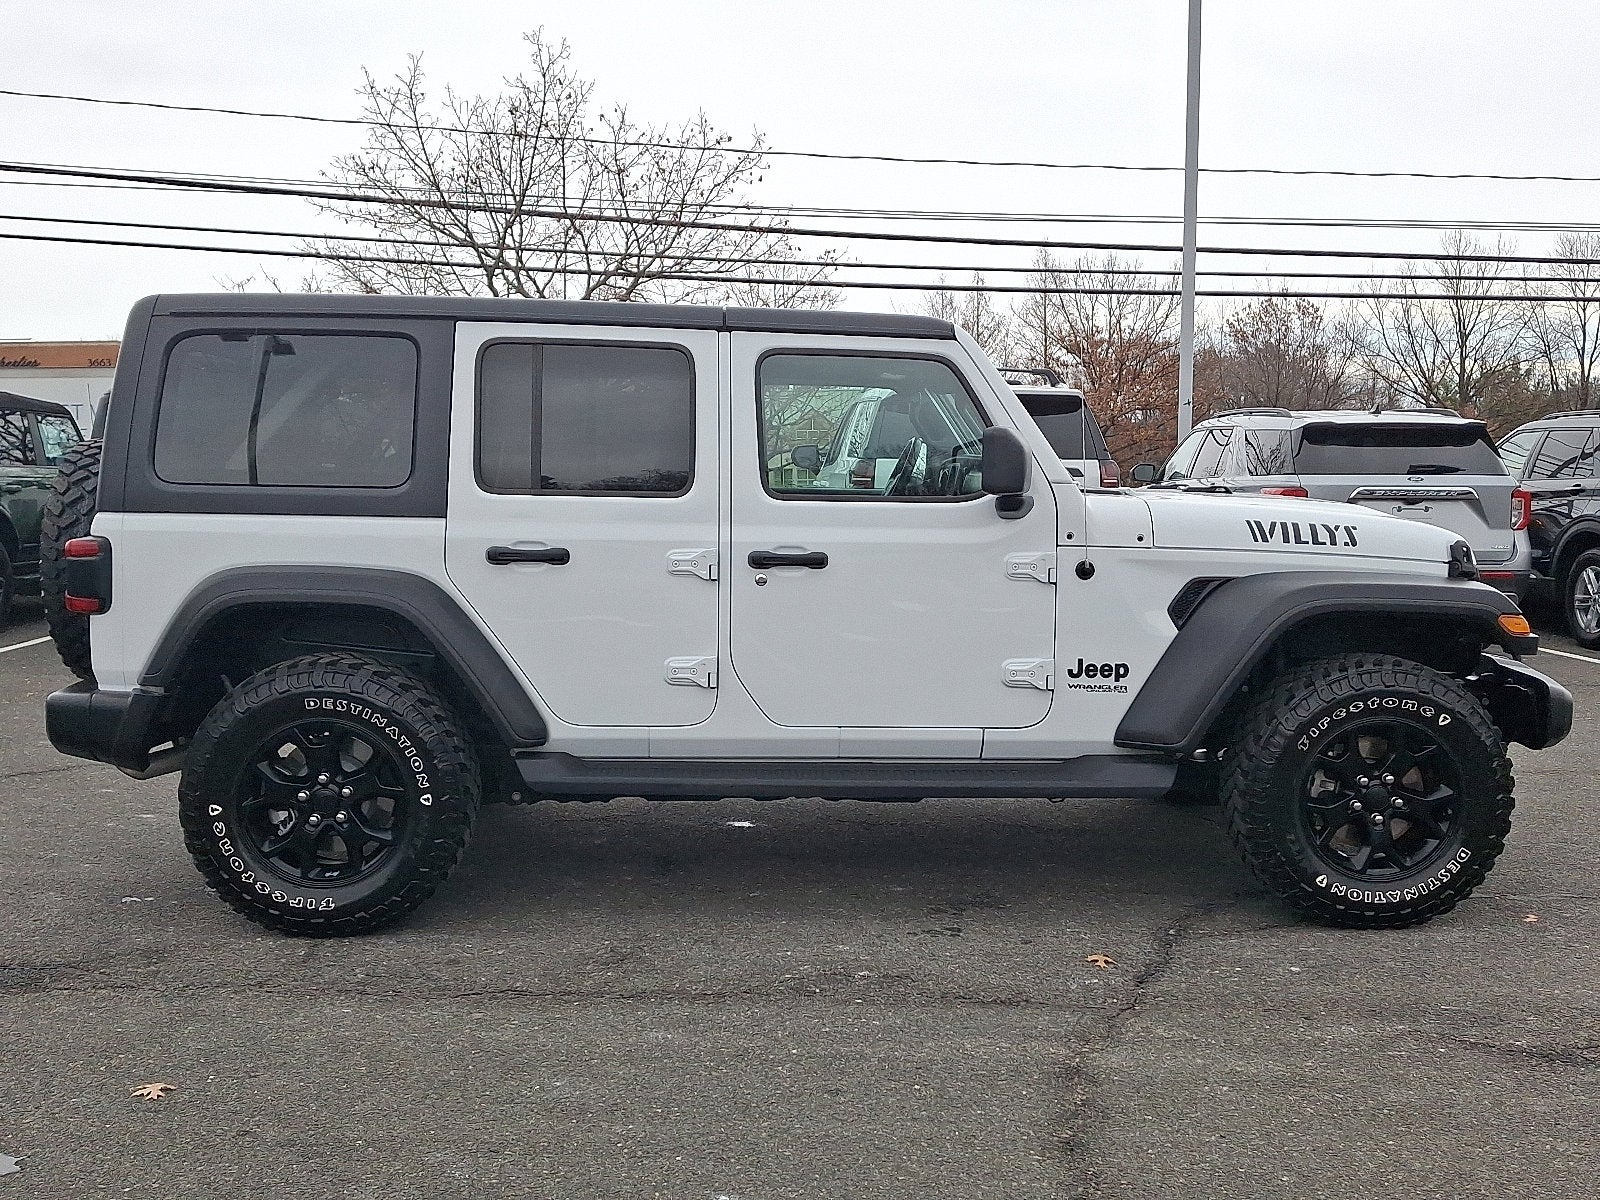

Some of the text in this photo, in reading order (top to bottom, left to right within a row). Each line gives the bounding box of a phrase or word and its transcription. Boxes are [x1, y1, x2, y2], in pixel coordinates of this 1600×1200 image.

[87, 358, 112, 367] 3663
[1244, 519, 1358, 548] WILLYS
[1067, 658, 1129, 682] Jeep
[304, 697, 431, 789] DESTINATION
[1330, 846, 1472, 904] DESTINATION
